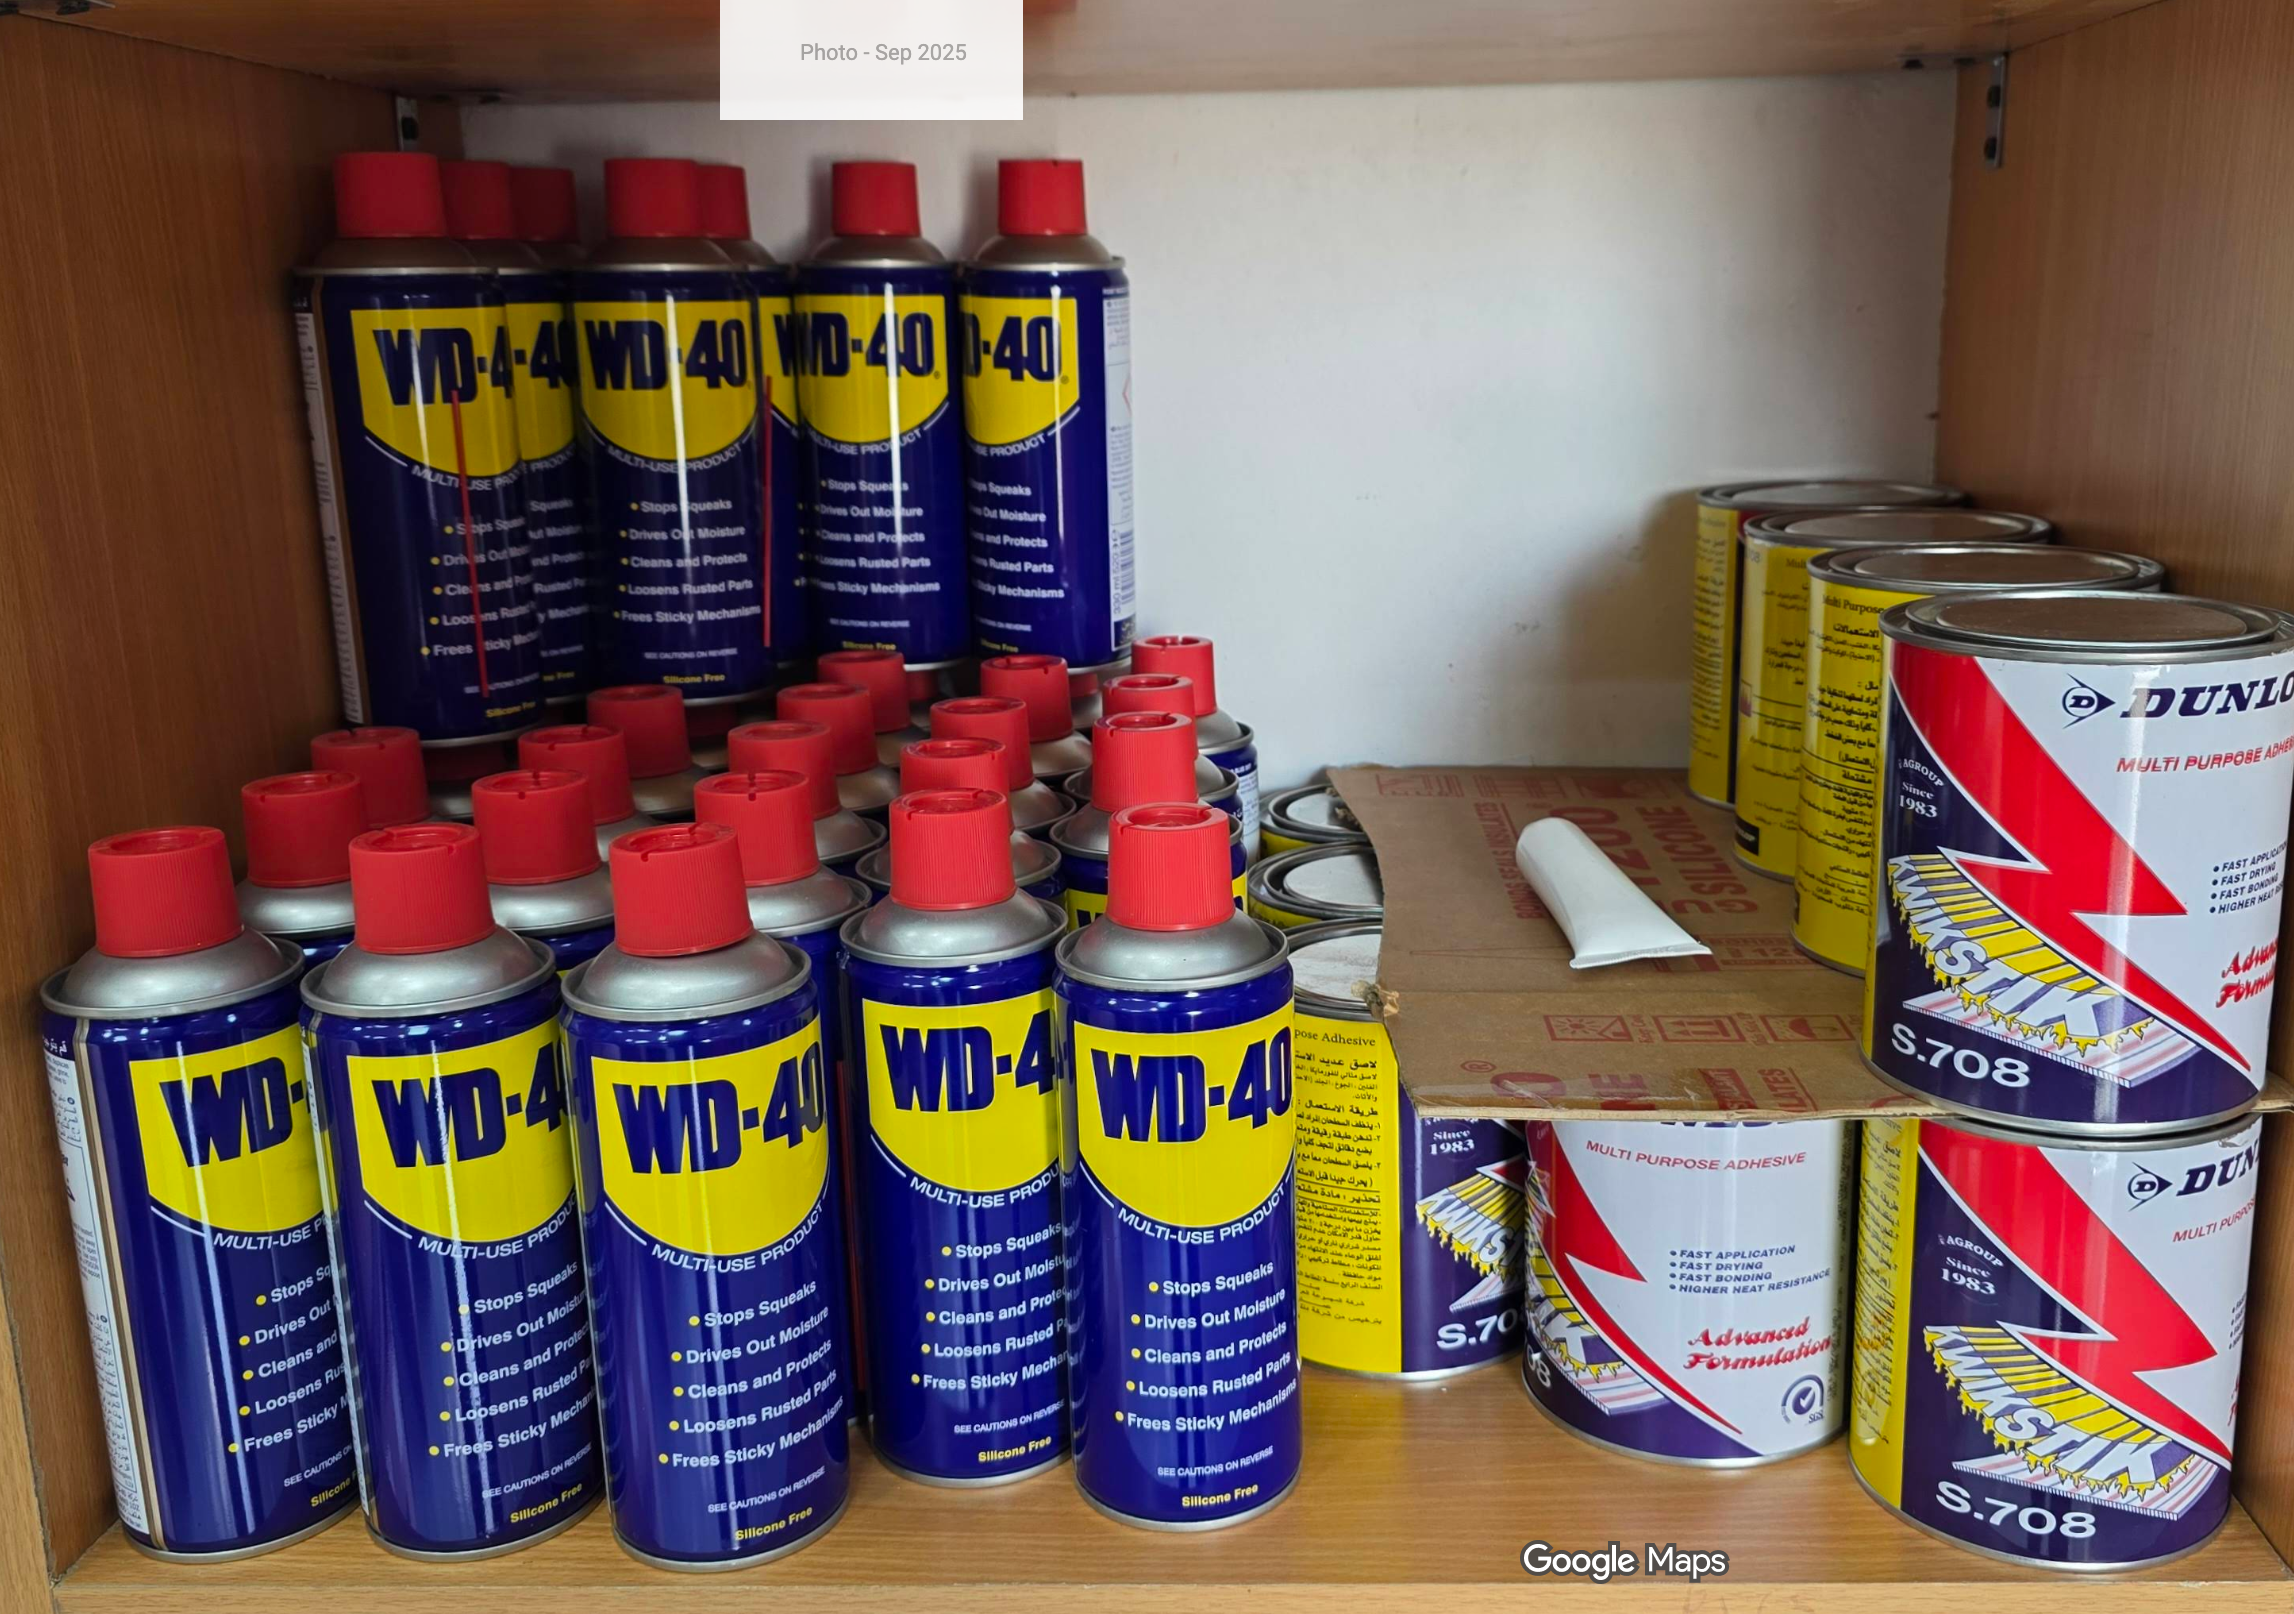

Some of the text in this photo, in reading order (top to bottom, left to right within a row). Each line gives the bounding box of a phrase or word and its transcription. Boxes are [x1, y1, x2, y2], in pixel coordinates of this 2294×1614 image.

[584, 319, 748, 390] WD-40
[991, 433, 1045, 456] PRODUCT
[989, 482, 1032, 496] Squeaks
[641, 501, 677, 514] Stops
[1000, 508, 1046, 522] Moisture
[629, 525, 746, 540] Drives Moisture
[1003, 536, 1048, 548] Protects
[630, 552, 748, 568] Cleans and Protects
[628, 578, 753, 595] Loosens Rusted Parts
[838, 581, 940, 595] Sticky Mechanisms
[998, 584, 1065, 598] Mechanisms
[622, 605, 761, 624] Frees Sticky Mechanisms
[1843, 599, 1884, 615] Purpose
[2120, 671, 2294, 718] DUNLO
[2116, 747, 2263, 772] MULTI PURPOSE
[1902, 780, 1934, 800] Since
[1899, 794, 1938, 818] 1983
[1636, 807, 1747, 894] SILICONE
[2220, 861, 2276, 886] FAST DRYING
[2222, 858, 2248, 872] FAST
[2217, 896, 2256, 914] HIGHER
[1294, 1029, 1376, 1046] pose Adhesive
[880, 1008, 1056, 1113] WD-4
[1891, 1022, 2031, 1088] S.708
[1090, 1026, 1292, 1143] WD-40
[372, 1041, 568, 1168] WD-4
[612, 1041, 824, 1174] WD-40
[1429, 1139, 1475, 1155] 1983
[1433, 1129, 1471, 1141] Since
[1586, 1140, 1807, 1170] MULTI PURPOSE ADHESIVE
[2176, 1142, 2260, 1197] DUN
[910, 1176, 1005, 1208] MULTI-USE
[1118, 1206, 1214, 1244] MULTI-USE
[1219, 1184, 1286, 1241] PRODUCT
[213, 1226, 312, 1250] MULTI-USE
[651, 1199, 823, 1274] MULTI-USE PRODUCT
[956, 1221, 1062, 1259] Stops Squeaks
[2172, 1222, 2217, 1242] MULTI
[418, 1236, 523, 1259] MULTI-USE
[1679, 1244, 1796, 1260] FAST APPLICATION
[1162, 1261, 1274, 1297] Stops Squeaks
[1679, 1261, 1764, 1271] FAST DRYING
[1679, 1271, 1772, 1283] FAST BONDING
[1945, 1256, 1992, 1278] Since
[271, 1276, 314, 1303] Stops
[474, 1260, 578, 1315] Stops Squeaks
[938, 1269, 1021, 1292] Drives Out
[1678, 1267, 1831, 1294] HIGHER HEAT RESISTANCE
[1941, 1267, 1996, 1295] 1983
[704, 1279, 817, 1328] Stops Squeaks
[938, 1300, 1026, 1325] Cleans and
[1144, 1288, 1286, 1330] Drives Out Moisture
[457, 1326, 513, 1352] Drives
[686, 1305, 829, 1364] Drives Out Moisture
[934, 1325, 1054, 1358] Loosens Rusted
[1436, 1307, 1518, 1349] S.70
[1688, 1315, 1811, 1347] Advanced
[1144, 1321, 1287, 1364] Cleans and Protects
[1683, 1334, 1832, 1371] Formulation
[459, 1347, 551, 1386] Cleans and
[687, 1338, 832, 1400] Cleans and Protects
[1139, 1350, 1292, 1398] Loosens Rusted Parts
[455, 1368, 578, 1422] Loosens Rusted
[923, 1370, 1018, 1392] Frees Sticky
[254, 1378, 322, 1415] Loosens
[683, 1368, 837, 1435] Loosens Rusted Parts
[1127, 1378, 1297, 1433] Frees Sticky Mechanisms
[672, 1395, 843, 1468] Frees Sticky Mechanisms
[978, 1435, 1053, 1463] Silicone Free
[1157, 1445, 1274, 1477] SEE CAUTIONS ON REVERSE
[728, 1465, 826, 1510] CAUTIONS REVERSE
[1181, 1483, 1259, 1507] Silicone Free
[735, 1505, 813, 1541] Silicone Free
[1935, 1481, 2097, 1538] S.708
